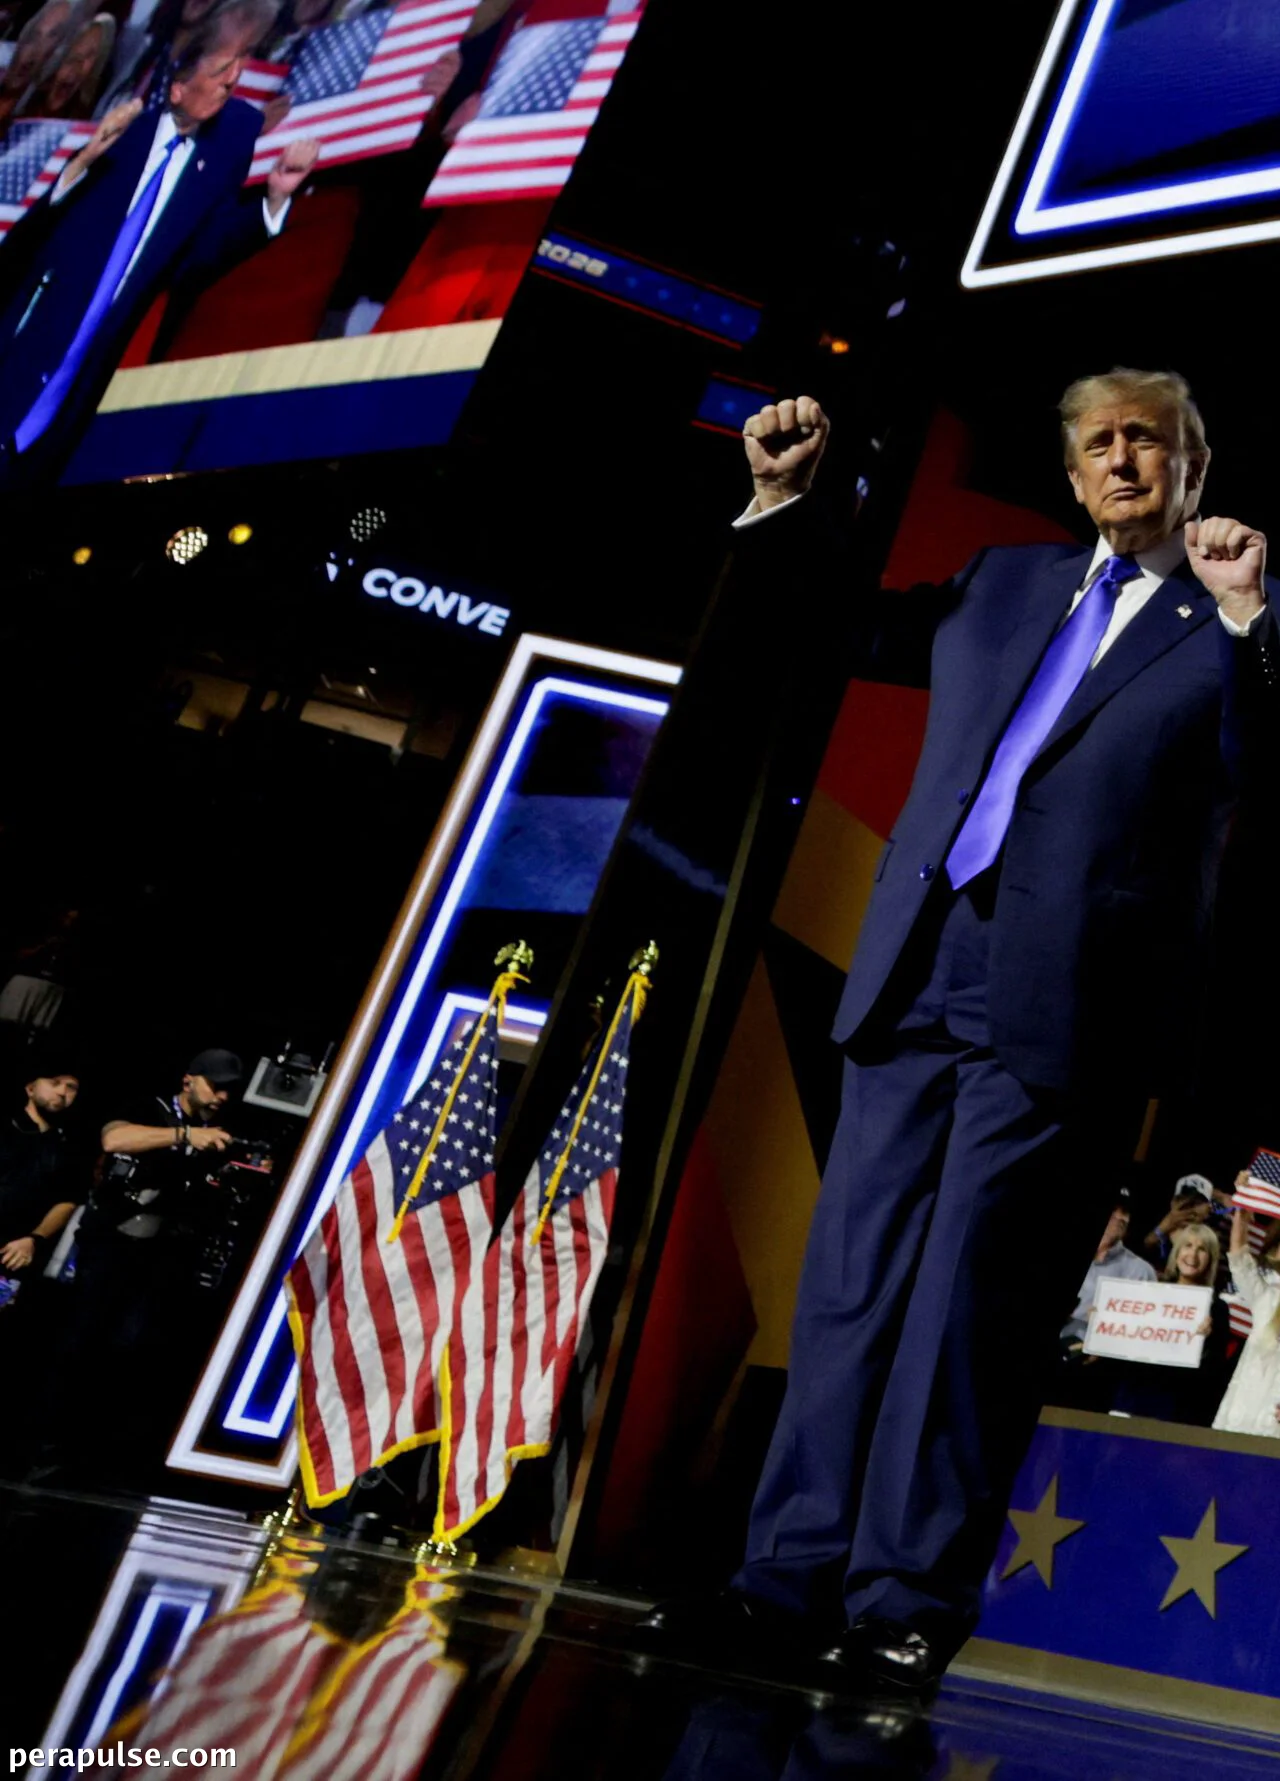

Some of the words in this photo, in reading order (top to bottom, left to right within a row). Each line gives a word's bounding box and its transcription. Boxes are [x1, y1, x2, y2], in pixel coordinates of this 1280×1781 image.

[1105, 1298, 1156, 1315] KEEP
[1162, 1304, 1197, 1320] THE
[1096, 1321, 1195, 1345] MAJORITY
